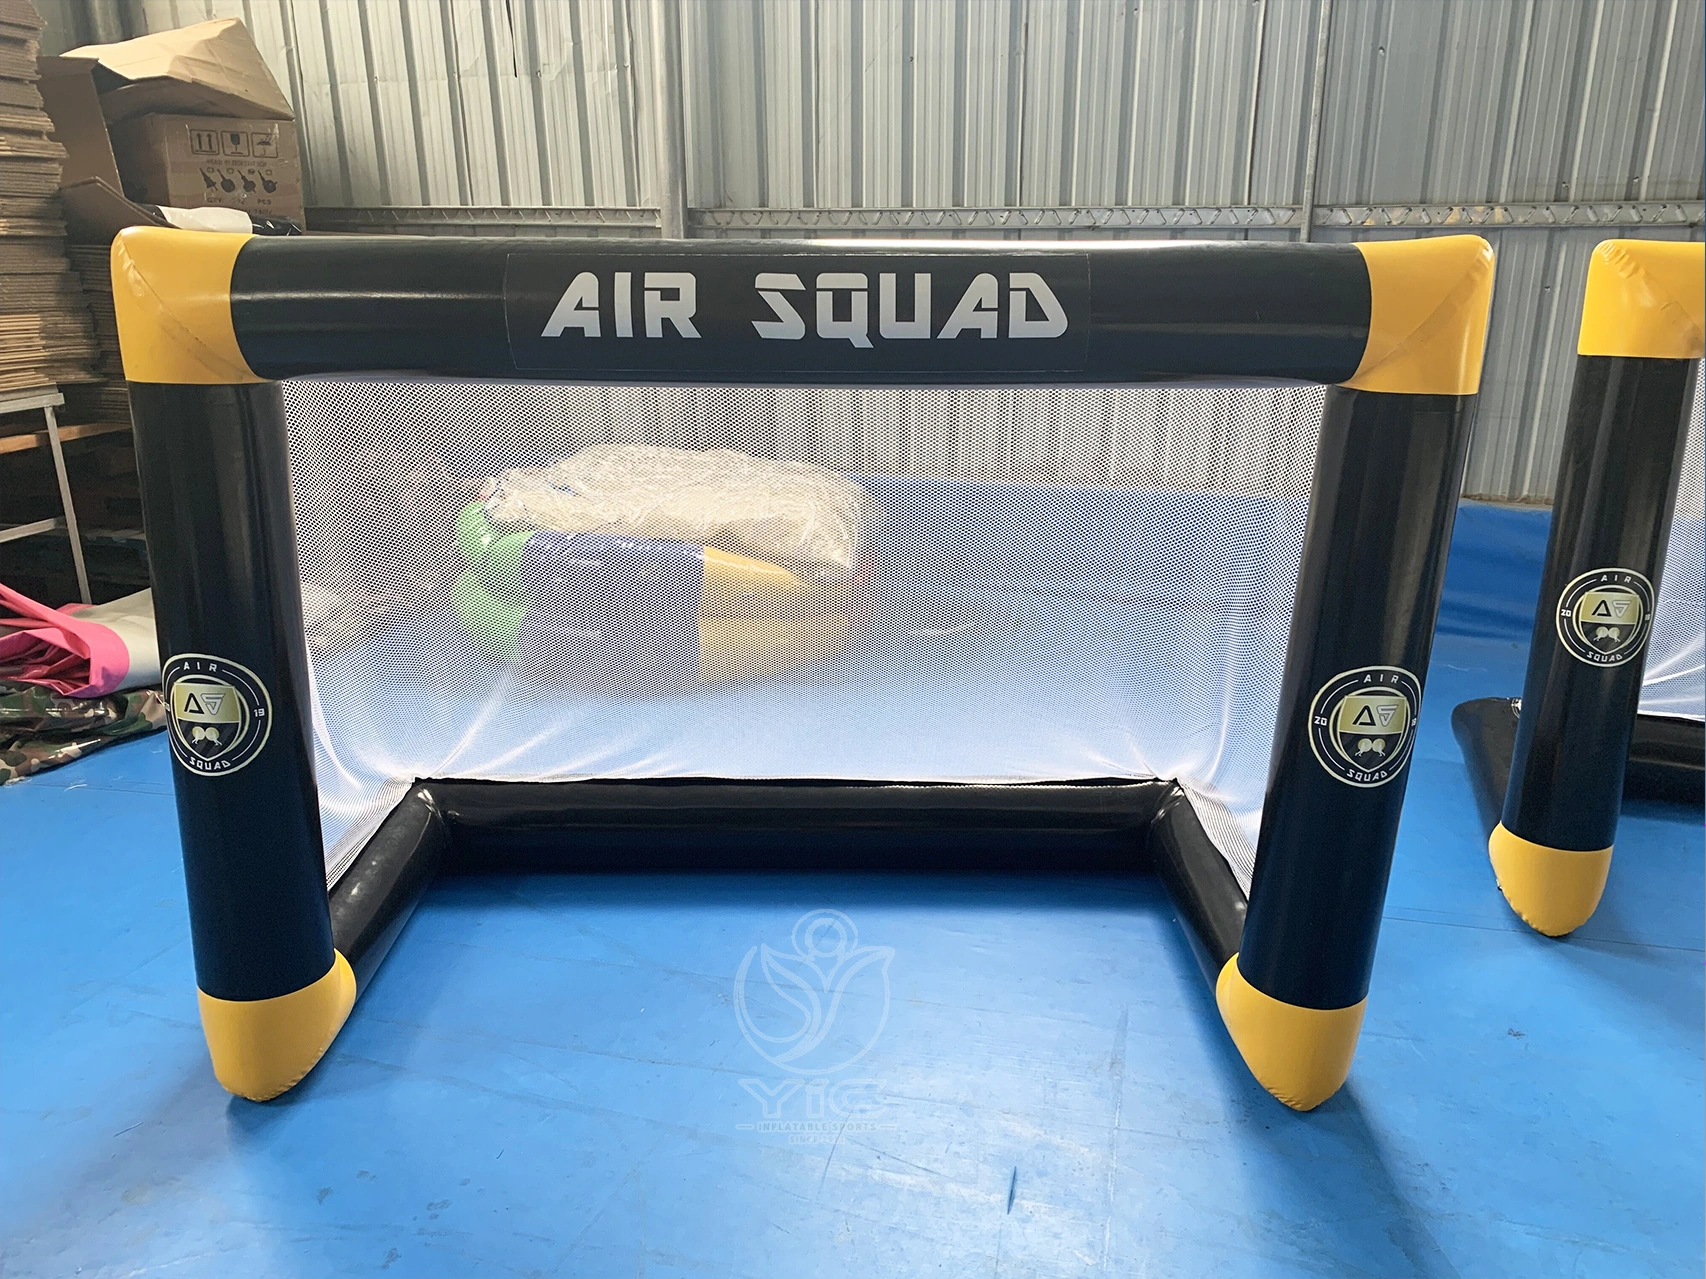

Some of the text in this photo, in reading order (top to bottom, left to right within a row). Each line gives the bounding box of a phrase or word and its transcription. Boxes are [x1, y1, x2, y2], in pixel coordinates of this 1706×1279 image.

[541, 272, 1069, 349] AIR SQUAD
[1600, 574, 1632, 584] AIR
[1586, 651, 1623, 662] SQUAD
[183, 661, 218, 673] AIR
[1363, 673, 1400, 684] AIR
[253, 708, 265, 717] 19
[1314, 715, 1328, 726] 20
[189, 756, 231, 770] SQUAD
[1346, 769, 1388, 782] SQUAD
